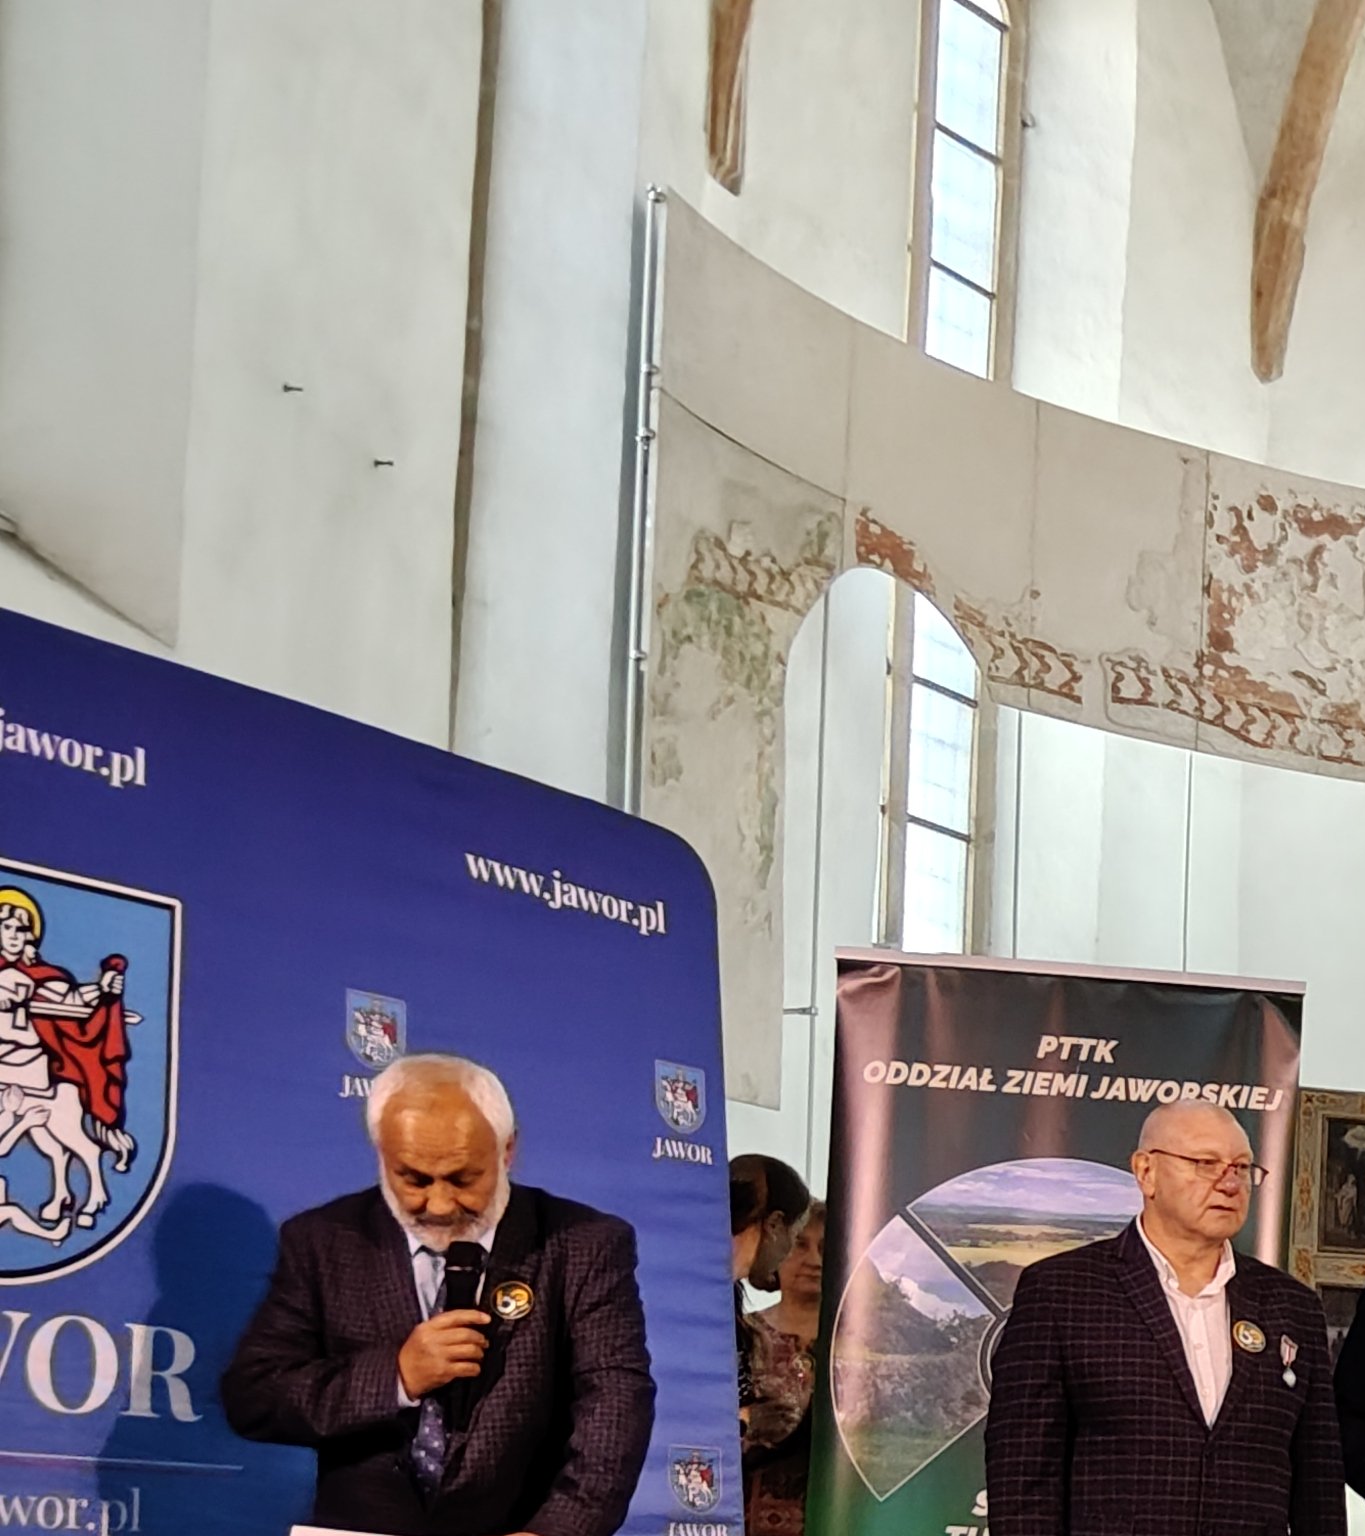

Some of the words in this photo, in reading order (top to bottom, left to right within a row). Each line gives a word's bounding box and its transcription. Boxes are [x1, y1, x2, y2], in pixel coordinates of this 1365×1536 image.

[0, 707, 147, 789] jawor.pl
[464, 852, 667, 937] www.jawor.pl
[1036, 1035, 1120, 1064] PTTK
[863, 1060, 997, 1094] ODDZIAŁ
[1001, 1069, 1088, 1099] ZIEMI
[651, 1136, 714, 1166] JAWOR
